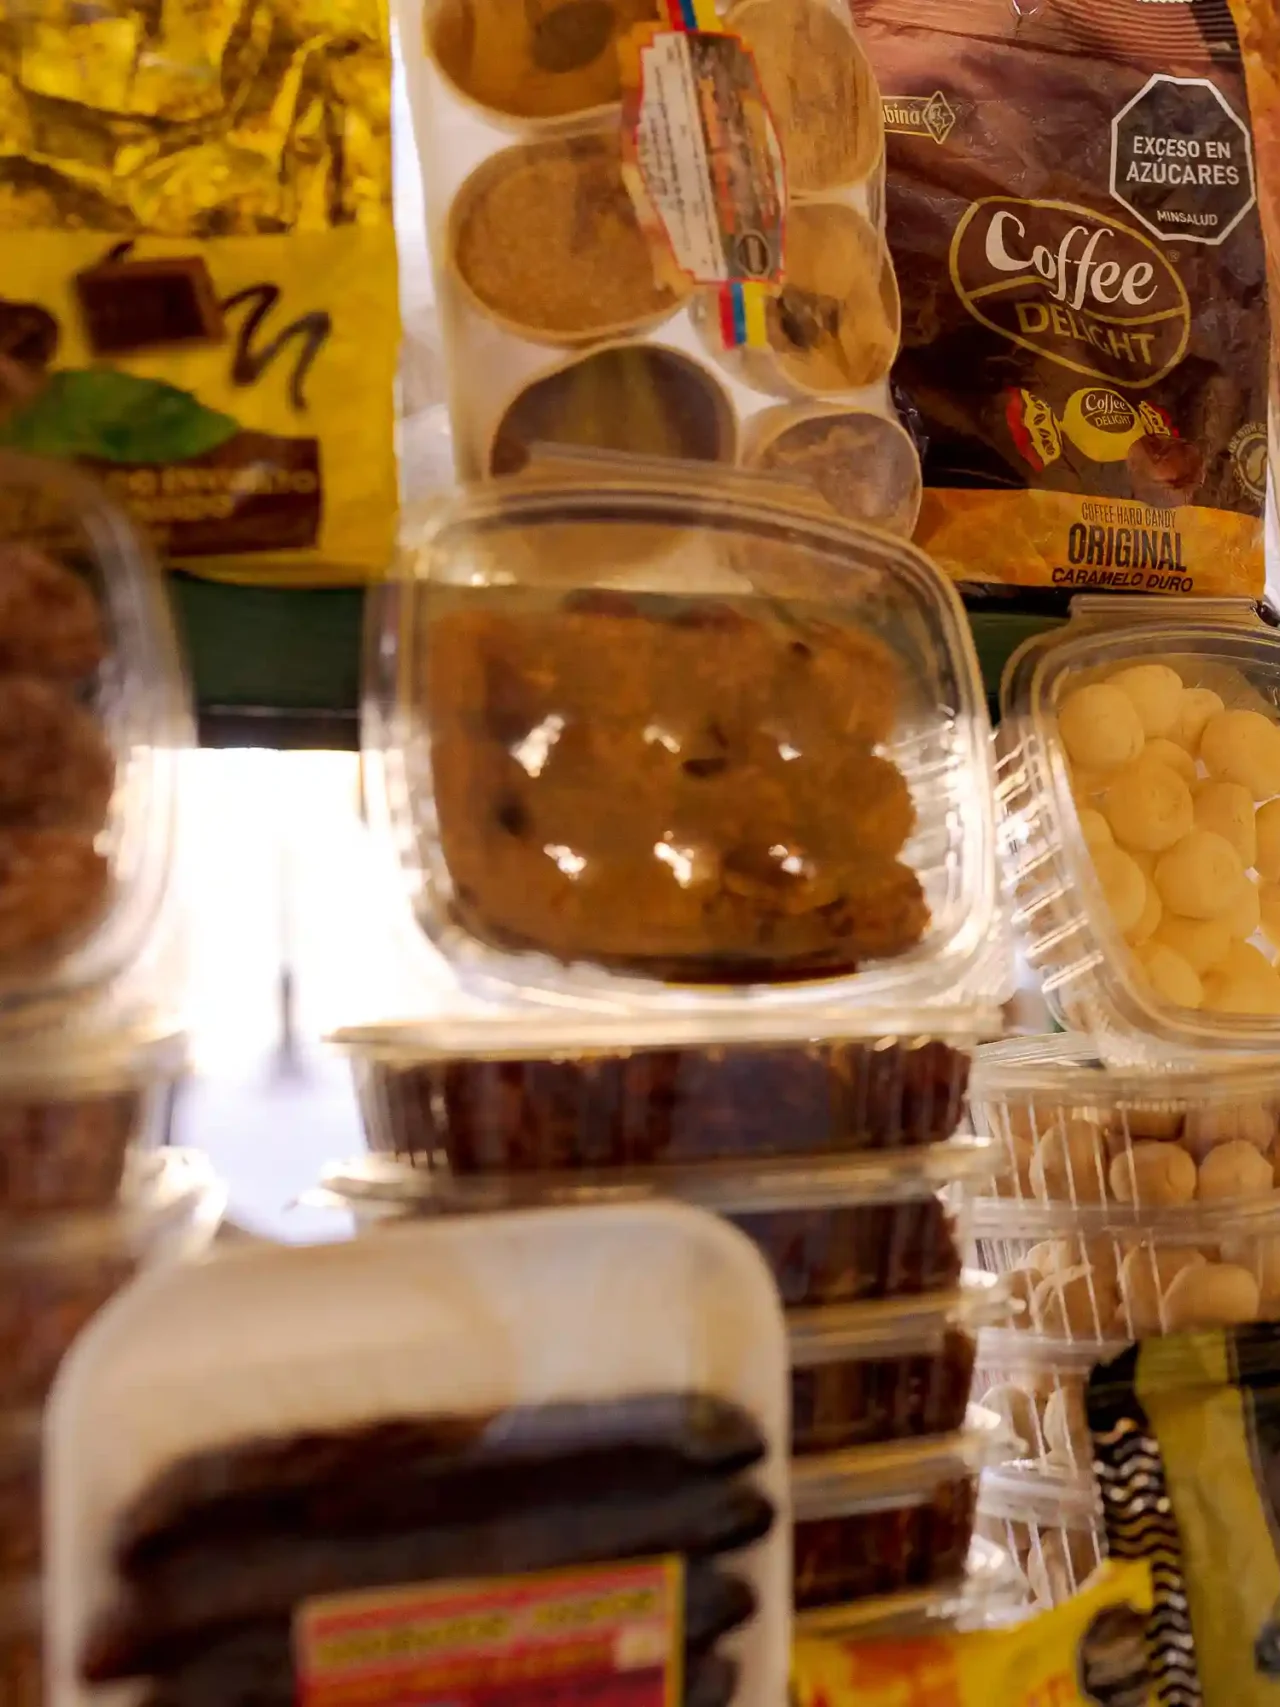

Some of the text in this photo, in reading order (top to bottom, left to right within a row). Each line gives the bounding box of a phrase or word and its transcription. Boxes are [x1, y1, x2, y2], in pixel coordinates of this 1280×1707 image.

[882, 103, 921, 125] bina
[1133, 135, 1231, 159] EXCESO EN
[1126, 157, 1240, 185] AZÚCARES
[1156, 210, 1218, 226] MINSALUD
[985, 210, 1158, 310] Coffee
[1015, 302, 1155, 365] DELIGHT
[1085, 393, 1127, 413] Coffee
[1095, 414, 1131, 427] DELIGHT
[1081, 502, 1177, 528] COFFEE HARD CANDY
[1068, 523, 1187, 573] ORIGINAL
[1052, 567, 1194, 592] CARAMELO DURO
